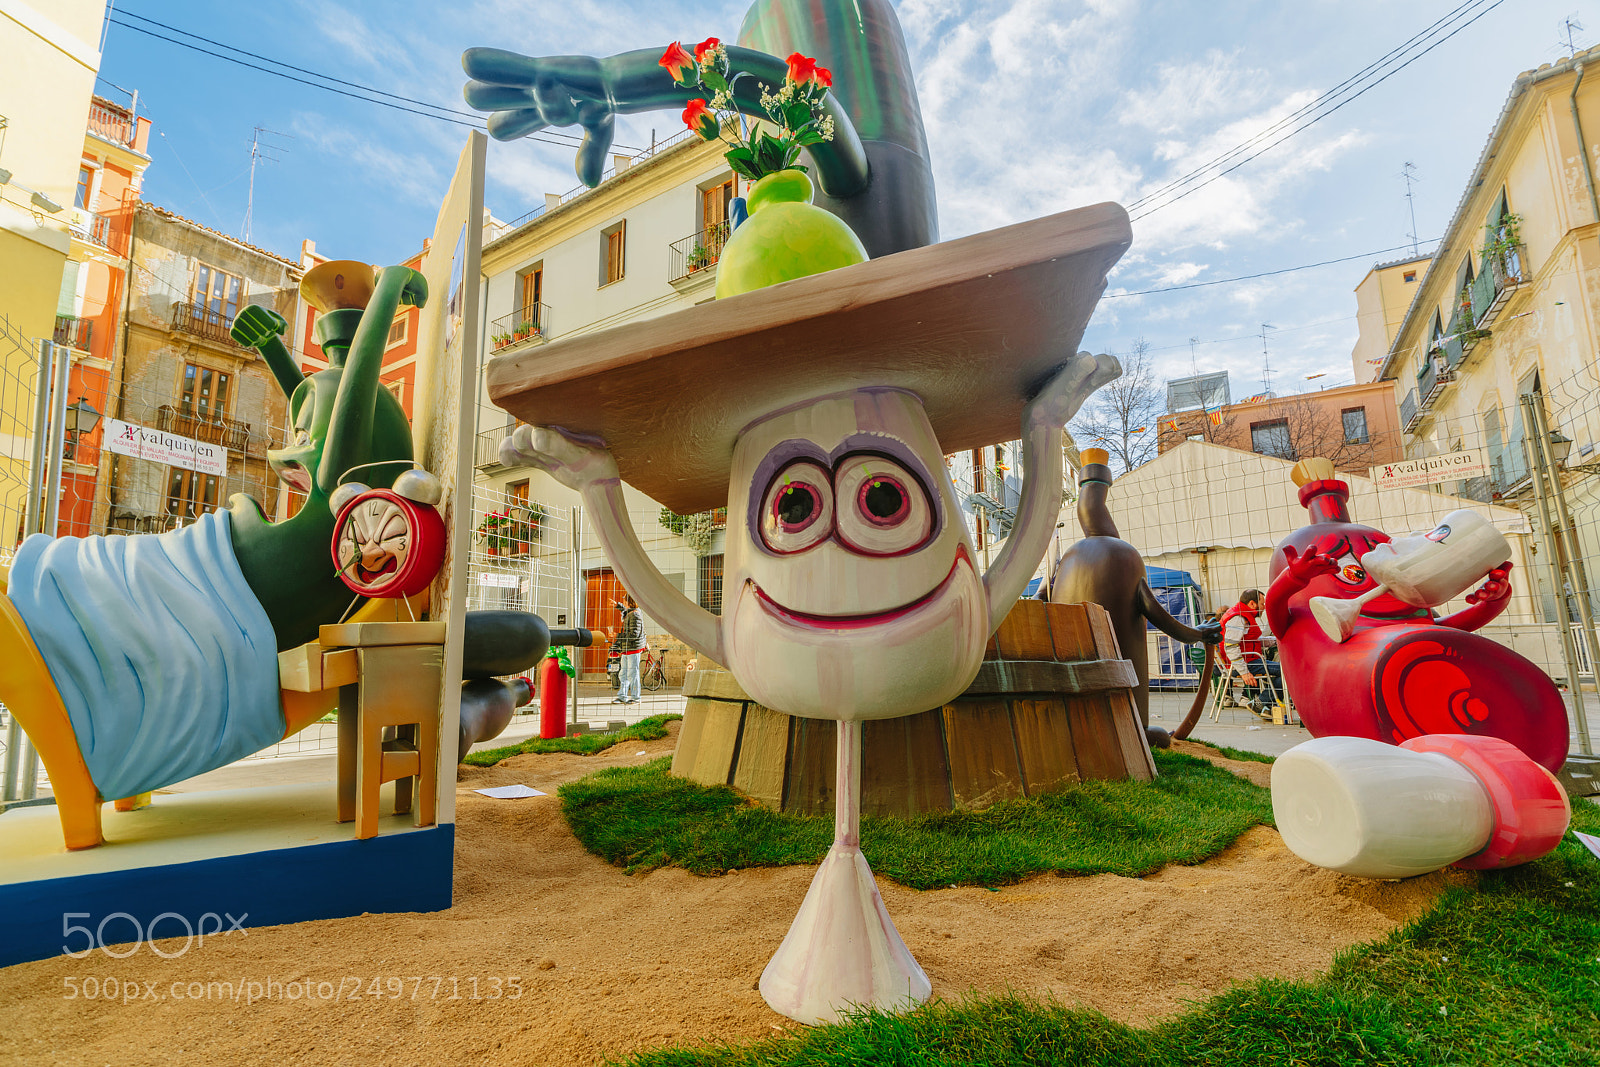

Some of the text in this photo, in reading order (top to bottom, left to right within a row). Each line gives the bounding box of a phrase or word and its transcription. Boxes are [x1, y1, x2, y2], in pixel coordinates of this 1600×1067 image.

[113, 439, 137, 449] ALQUILER
[147, 446, 165, 455] VALLAS
[200, 459, 220, 468] EQUIPOS
[141, 432, 214, 458] valquiven
[130, 449, 169, 462] PARA EVENTOS
[1397, 454, 1472, 474] valquiven
[367, 501, 380, 518] 12
[340, 545, 347, 559] 9
[397, 538, 407, 552] 3
